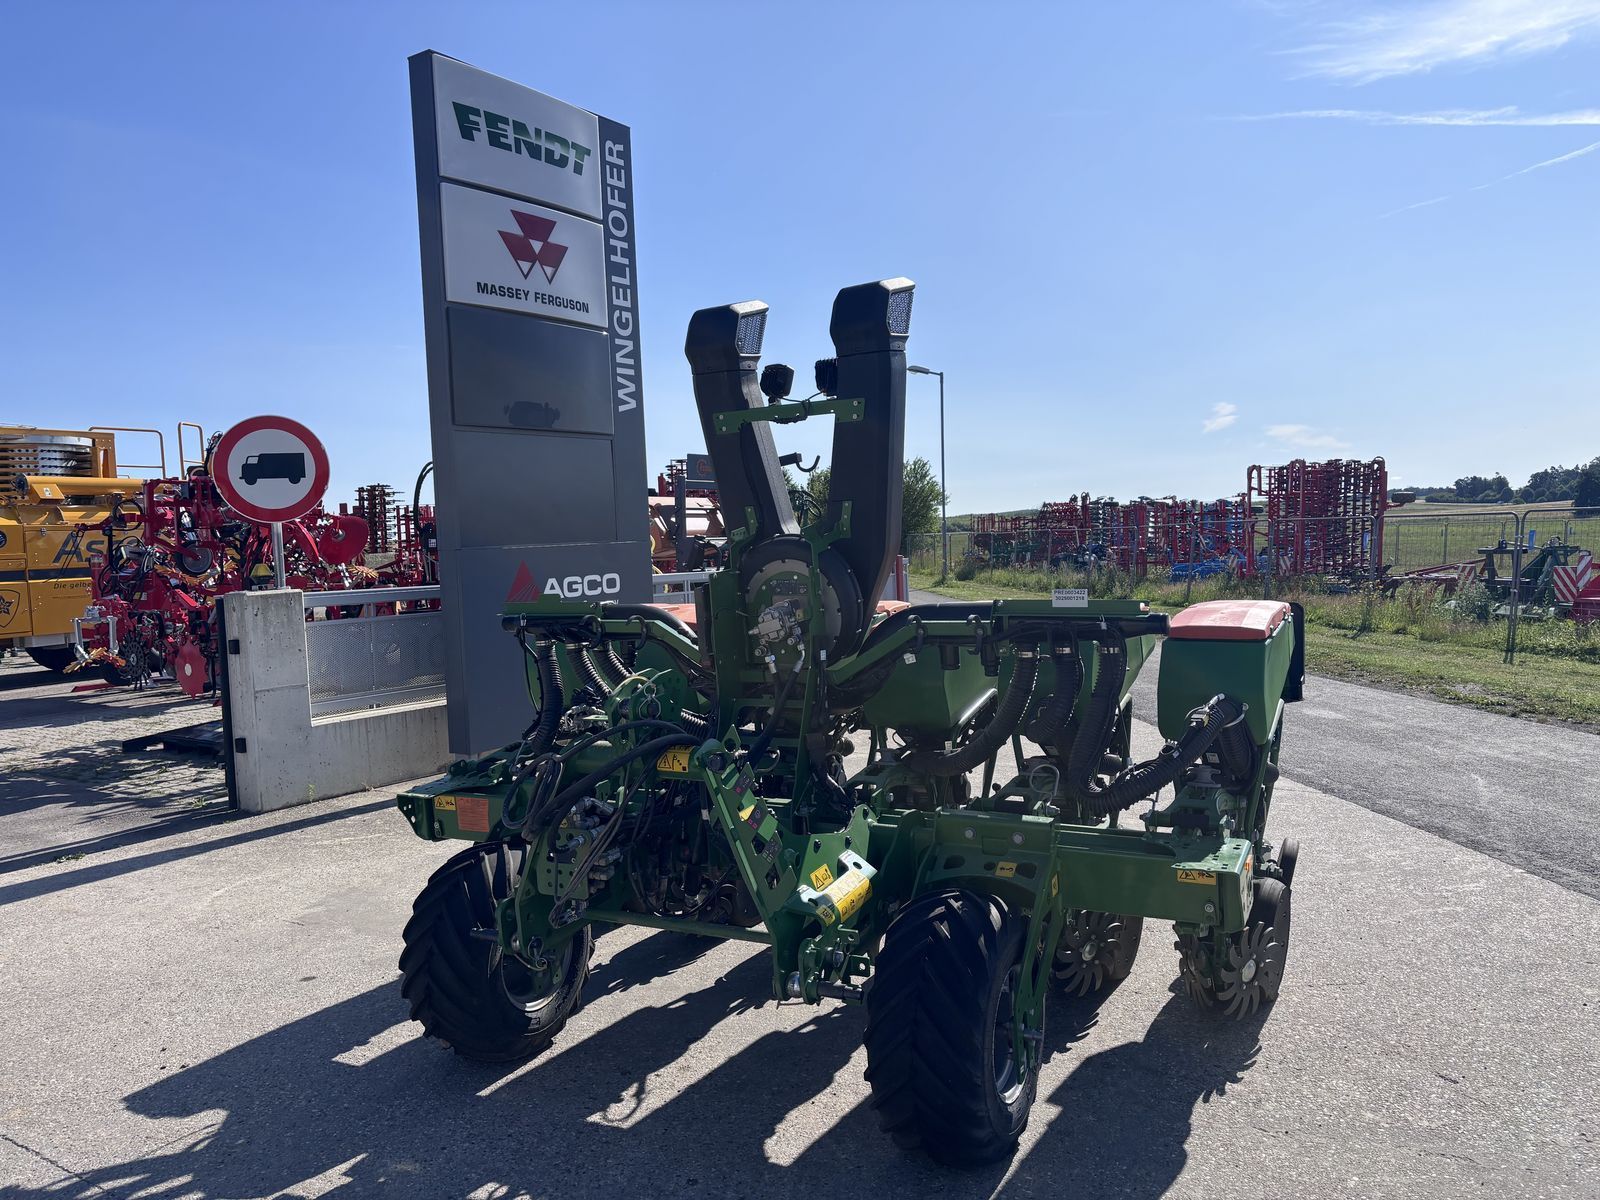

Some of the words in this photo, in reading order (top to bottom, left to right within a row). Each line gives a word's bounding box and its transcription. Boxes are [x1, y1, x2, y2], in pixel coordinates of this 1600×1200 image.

[452, 101, 591, 176] FENDT
[605, 140, 637, 412] WINGELHOFER
[476, 281, 530, 301] MASSEY
[534, 291, 589, 314] FERGUSON
[53, 582, 67, 590] Die
[543, 572, 621, 599] AGCO
